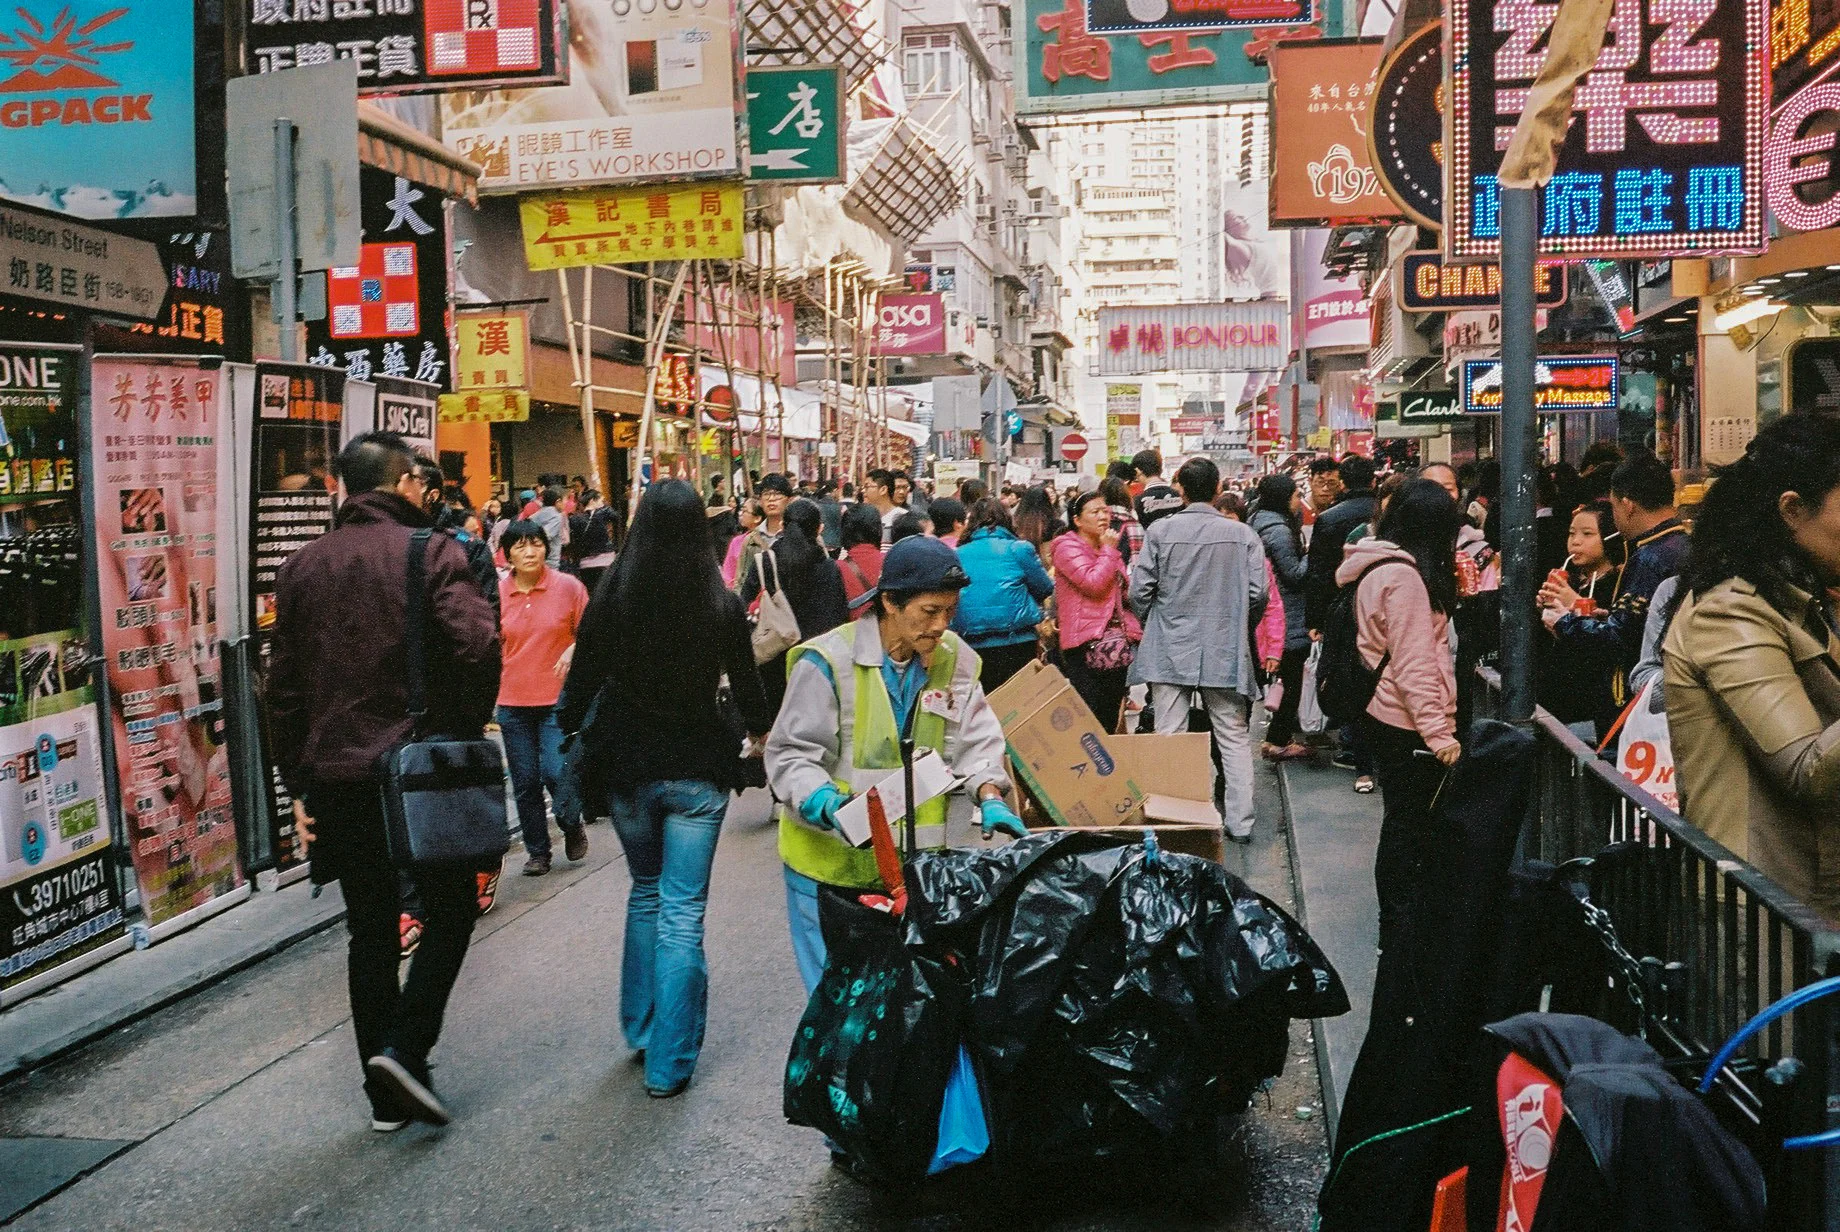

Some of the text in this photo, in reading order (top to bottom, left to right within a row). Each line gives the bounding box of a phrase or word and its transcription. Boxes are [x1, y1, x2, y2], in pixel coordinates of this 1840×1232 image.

[1, 94, 153, 128] GPACK
[517, 127, 633, 157] 眼鏡工作室
[518, 148, 726, 182] EYE'S WORKSHOP
[1329, 164, 1388, 204] 197
[383, 176, 436, 235] 大
[545, 190, 722, 228] 漢記書局
[1, 213, 109, 260] Nelson Street
[9, 256, 101, 302] 奶路臣街
[1417, 263, 1552, 299] CHANE
[477, 321, 510, 356] 漢
[1173, 324, 1282, 350] BONJOUR
[109, 373, 214, 422] 芳芳美甲
[1402, 398, 1462, 418] Clark
[1547, 388, 1613, 406] Massage
[1070, 761, 1089, 780] A
[1624, 741, 1657, 786] 9
[1115, 797, 1133, 815] 3
[31, 857, 105, 913] 39710251
